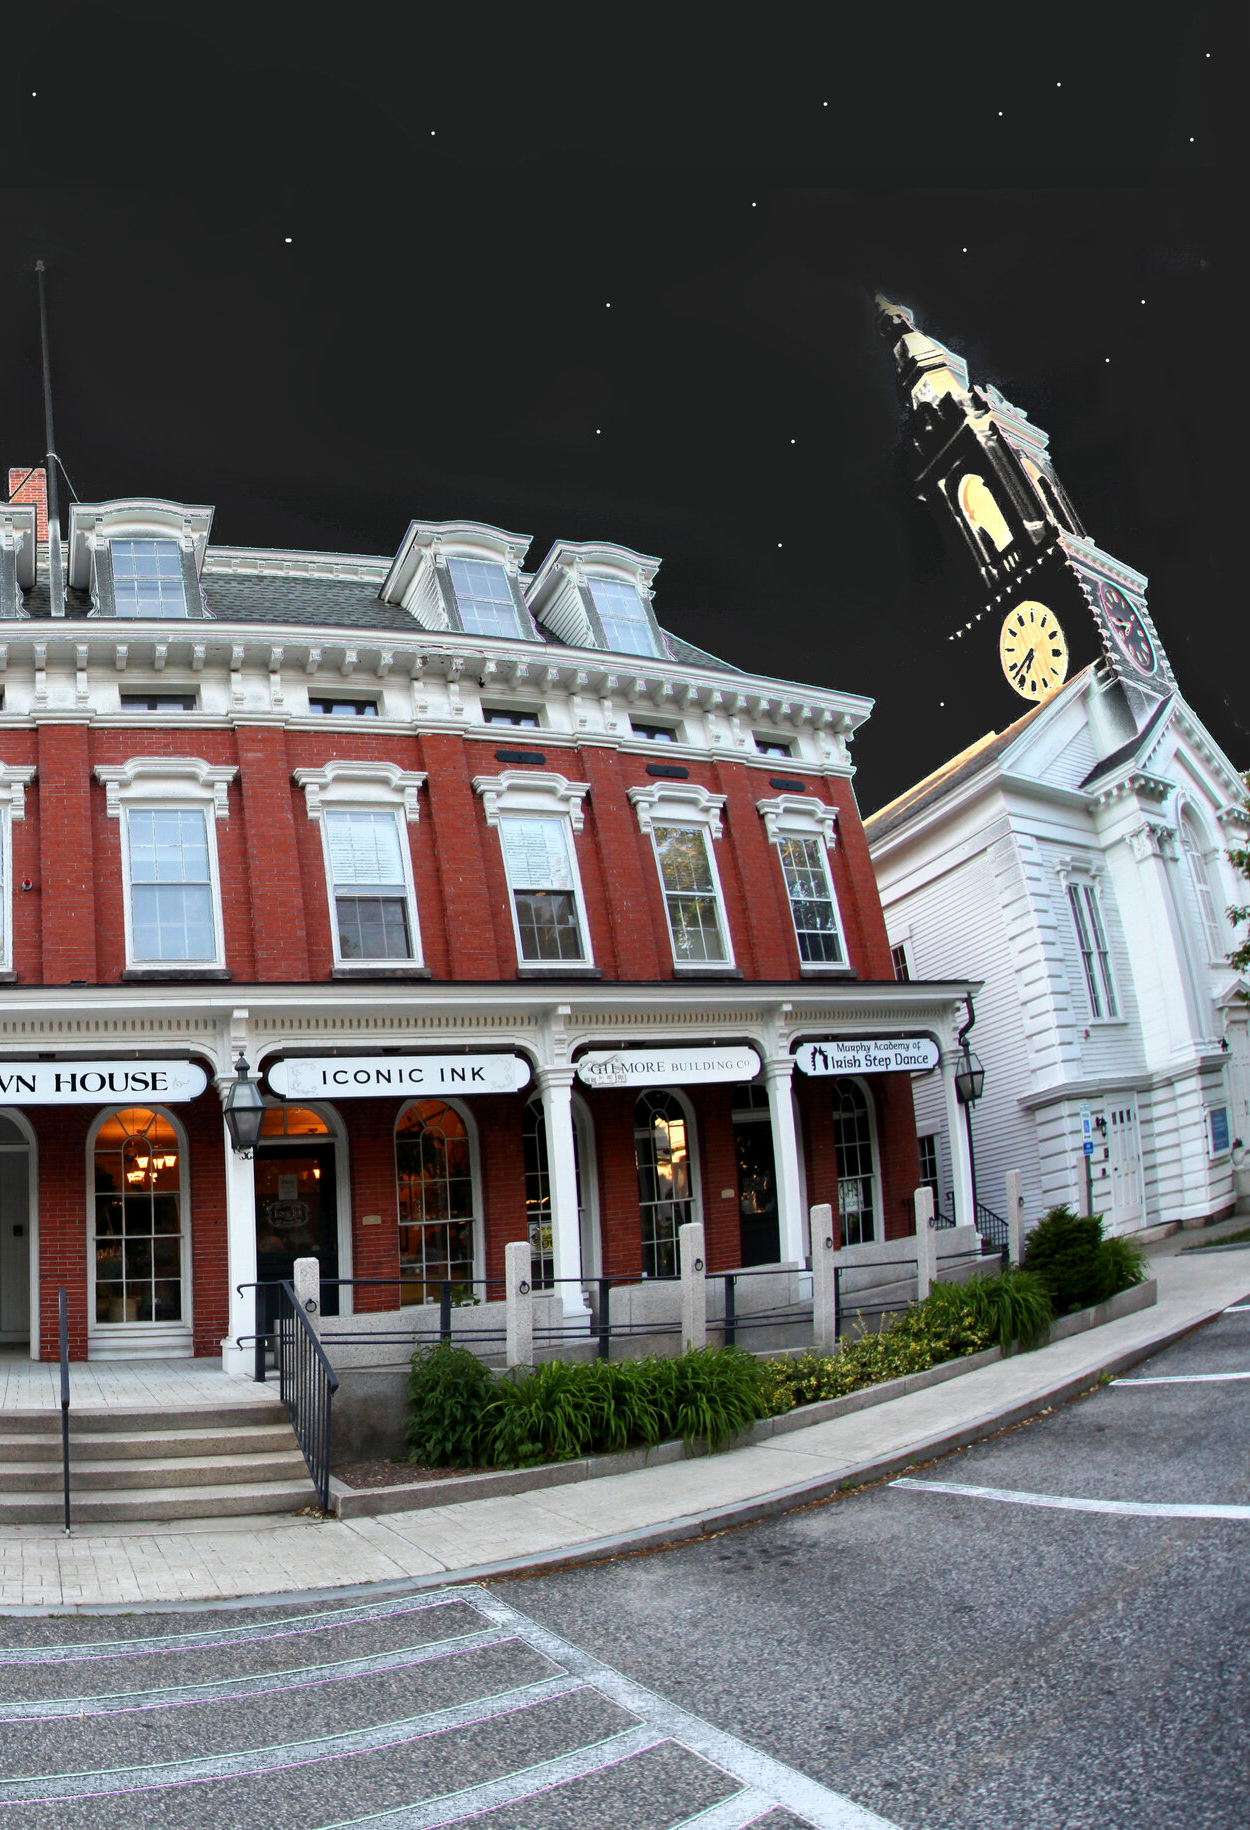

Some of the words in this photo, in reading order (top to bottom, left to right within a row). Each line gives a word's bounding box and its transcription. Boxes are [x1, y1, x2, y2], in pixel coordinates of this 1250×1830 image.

[836, 1043, 871, 1054] Murphy
[873, 1041, 910, 1052] Academy
[912, 1041, 921, 1050] of
[590, 1061, 666, 1075] GILMORE
[671, 1061, 734, 1072] BUILDING
[831, 1055, 861, 1069] Irish
[864, 1054, 891, 1069] Step
[894, 1053, 929, 1066] Dance
[54, 1071, 169, 1093] HOUSE
[322, 1068, 425, 1085] ICONIC
[439, 1066, 486, 1082] INK
